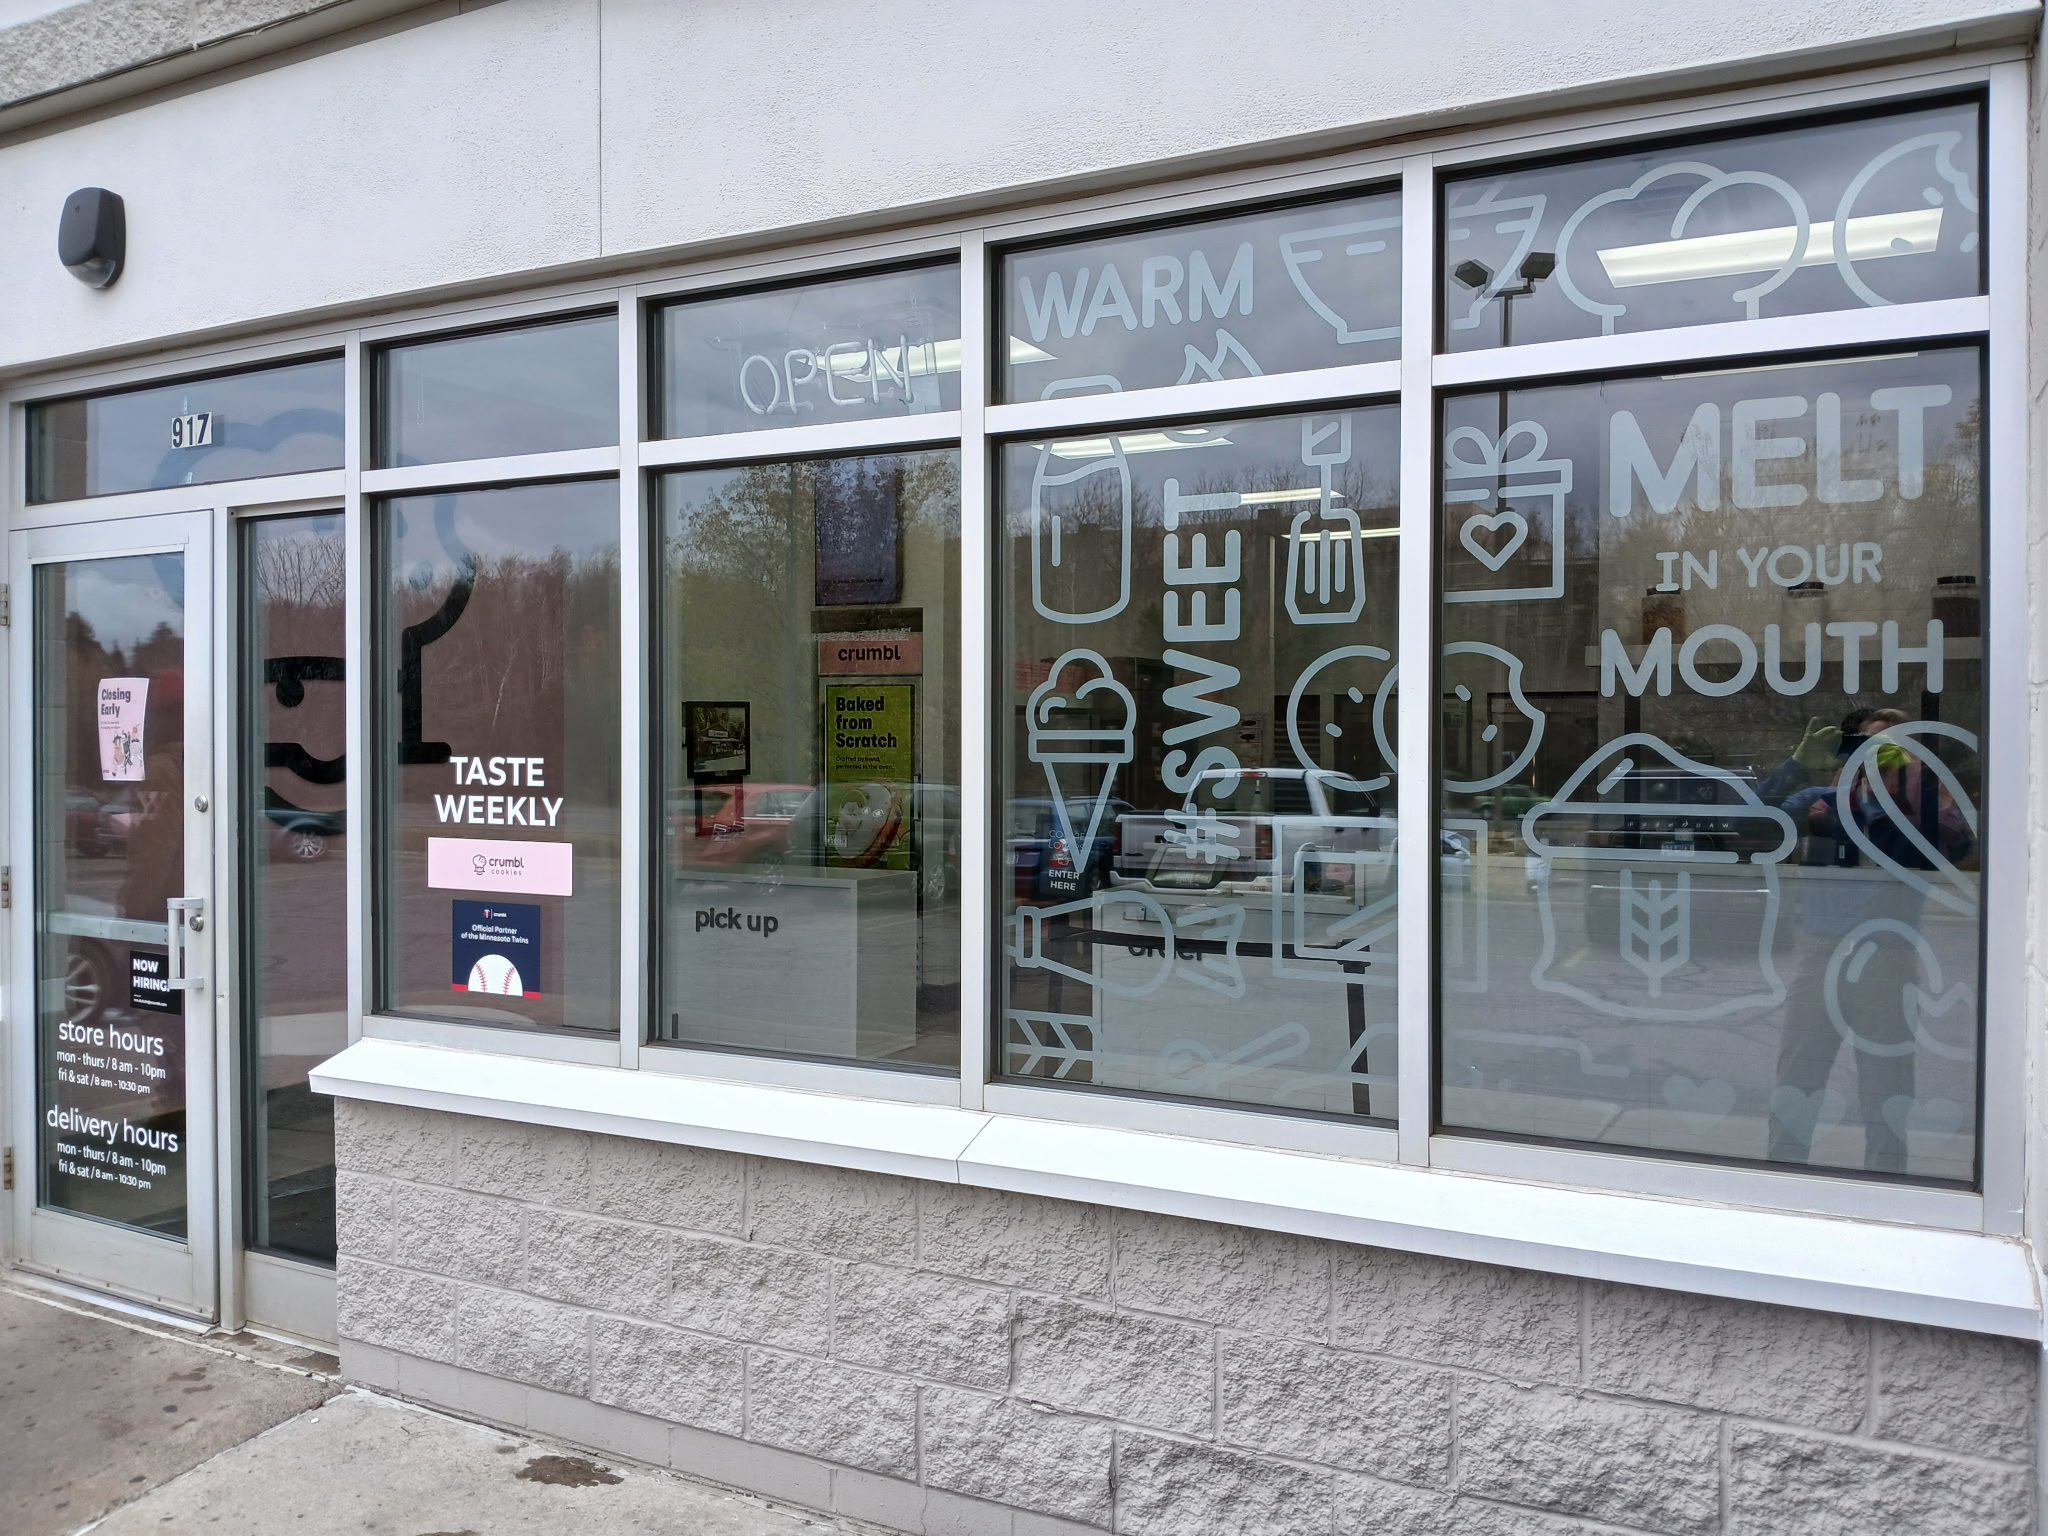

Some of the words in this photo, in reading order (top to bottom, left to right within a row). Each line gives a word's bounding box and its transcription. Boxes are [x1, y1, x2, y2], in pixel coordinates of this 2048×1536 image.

[1018, 242, 1254, 342] WARM
[740, 335, 914, 415] OPEN
[173, 413, 210, 447] 917
[1609, 384, 1953, 518] MELT
[1655, 549, 1717, 592] IN
[1736, 542, 1883, 588] YOUR
[838, 645, 902, 661] crumbl
[1600, 618, 1944, 698] MOUTH
[1161, 478, 1241, 864] #SWEET
[101, 688, 131, 703] Closing
[836, 696, 885, 712] Baked
[101, 703, 120, 718] Early
[836, 714, 872, 730] from
[836, 732, 897, 748] Scratch
[449, 756, 545, 787] TASTE
[434, 794, 564, 827] WEEKLY
[489, 856, 525, 868] crumbl
[491, 868, 522, 876] cookies
[1048, 869, 1080, 880] ENTER
[1050, 880, 1077, 891] HERE
[472, 924, 494, 933] Official
[494, 926, 518, 935] Partner
[695, 907, 742, 932] pick
[747, 915, 779, 938] up
[468, 932, 478, 940] the
[479, 934, 511, 943] Minnesota
[512, 936, 529, 945] Twins
[133, 958, 159, 973] NOW
[59, 1021, 104, 1046] store
[109, 1024, 164, 1056] hours
[57, 1051, 75, 1063] mon
[82, 1052, 104, 1069] thurs
[111, 1058, 118, 1070] 8
[119, 1061, 133, 1073] am
[141, 1062, 166, 1080] 10pm
[58, 1067, 67, 1081] fri
[68, 1070, 75, 1083] &
[76, 1074, 89, 1086] sat
[101, 1079, 112, 1088] am
[137, 1085, 150, 1094] pm
[47, 1105, 118, 1145] delivery
[123, 1118, 178, 1152] hours
[57, 1142, 76, 1155] mon
[83, 1145, 105, 1162] thurs
[112, 1152, 118, 1164] 8
[119, 1156, 133, 1168] am
[141, 1158, 166, 1176] 10pm
[58, 1159, 67, 1173] fri
[69, 1162, 76, 1175] &
[77, 1166, 89, 1178] sat
[102, 1171, 113, 1181] am
[138, 1179, 151, 1190] pm
